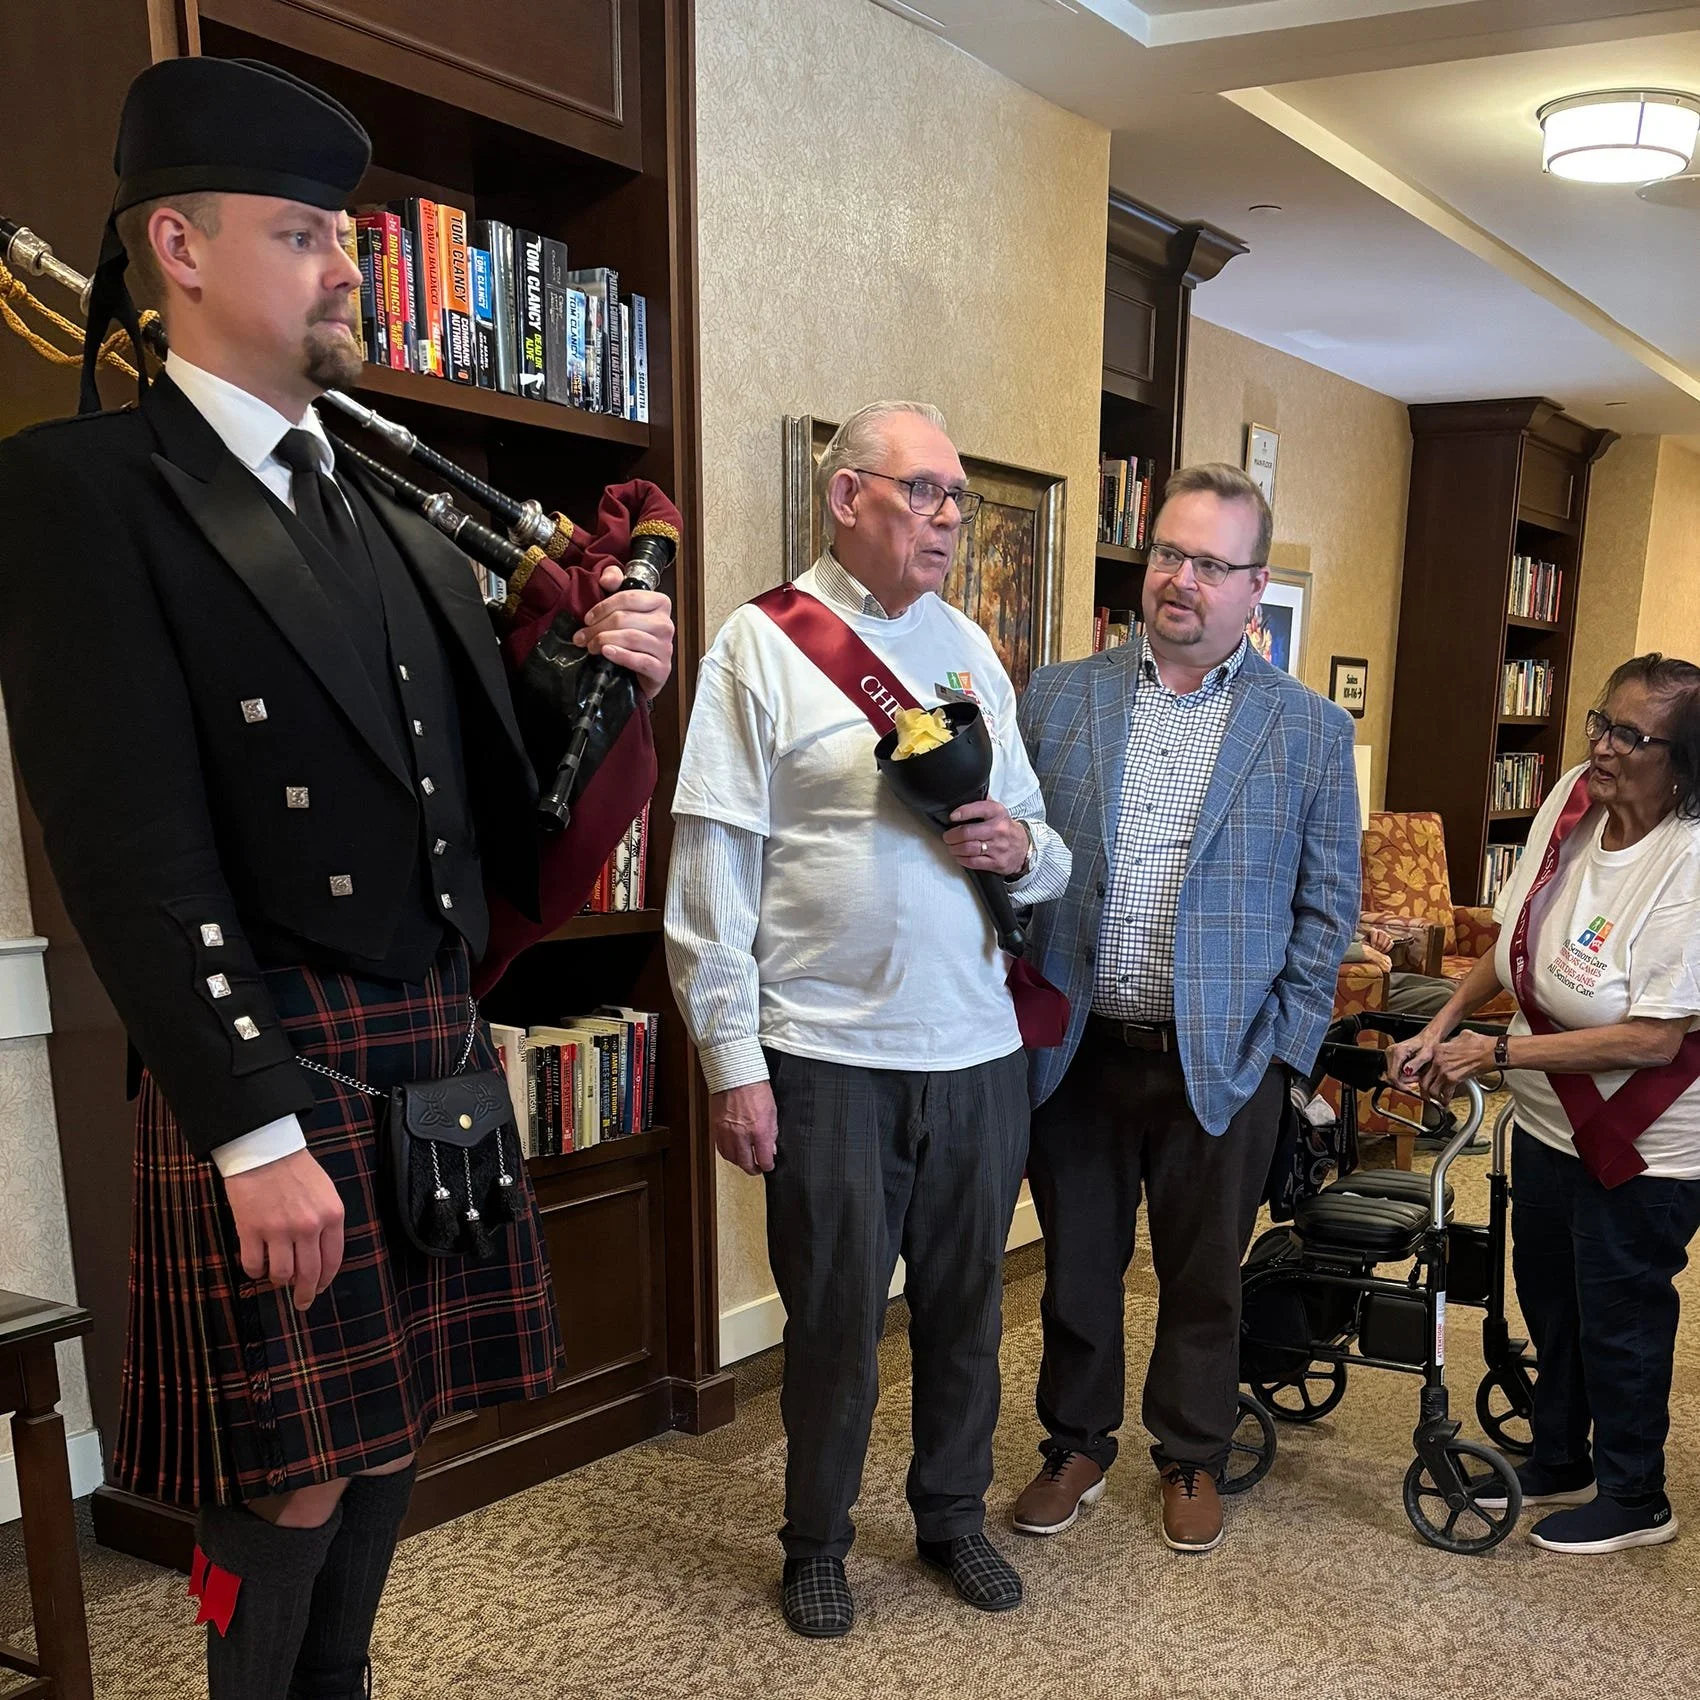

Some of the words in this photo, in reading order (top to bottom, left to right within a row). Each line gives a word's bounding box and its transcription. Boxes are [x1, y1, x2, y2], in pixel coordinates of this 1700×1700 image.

[426, 223, 437, 255] DAVID
[451, 216, 464, 246] TOM
[389, 233, 399, 265] DAVID
[475, 254, 485, 273] TOM
[526, 236, 542, 274] TOM
[373, 252, 384, 282] DAVID
[428, 256, 441, 305] BALDACCI
[452, 249, 467, 303] CLANCY
[375, 282, 387, 327] BALDACCI
[390, 267, 401, 317] BALDACCI
[476, 275, 487, 310] CLANCY
[526, 275, 543, 332] CLANCY
[568, 296, 577, 317] TOM
[451, 312, 464, 367] AUTHORITY
[461, 316, 471, 367] COMMAND
[525, 337, 535, 362] ALIVE
[534, 333, 543, 357] DEAD
[569, 318, 579, 359] CLANCY
[535, 357, 543, 369] OR
[611, 355, 620, 374] LAST
[638, 371, 646, 409] SCARPETTA
[1568, 943, 1592, 963] Seniors
[1590, 956, 1608, 971] Care
[1547, 963, 1556, 974] All
[1554, 969, 1576, 990] Seniors
[1575, 984, 1595, 998] Care
[601, 1051, 611, 1078] JAMES
[528, 1079, 538, 1115] PATTERSON
[602, 1079, 611, 1117] PATTERSON
